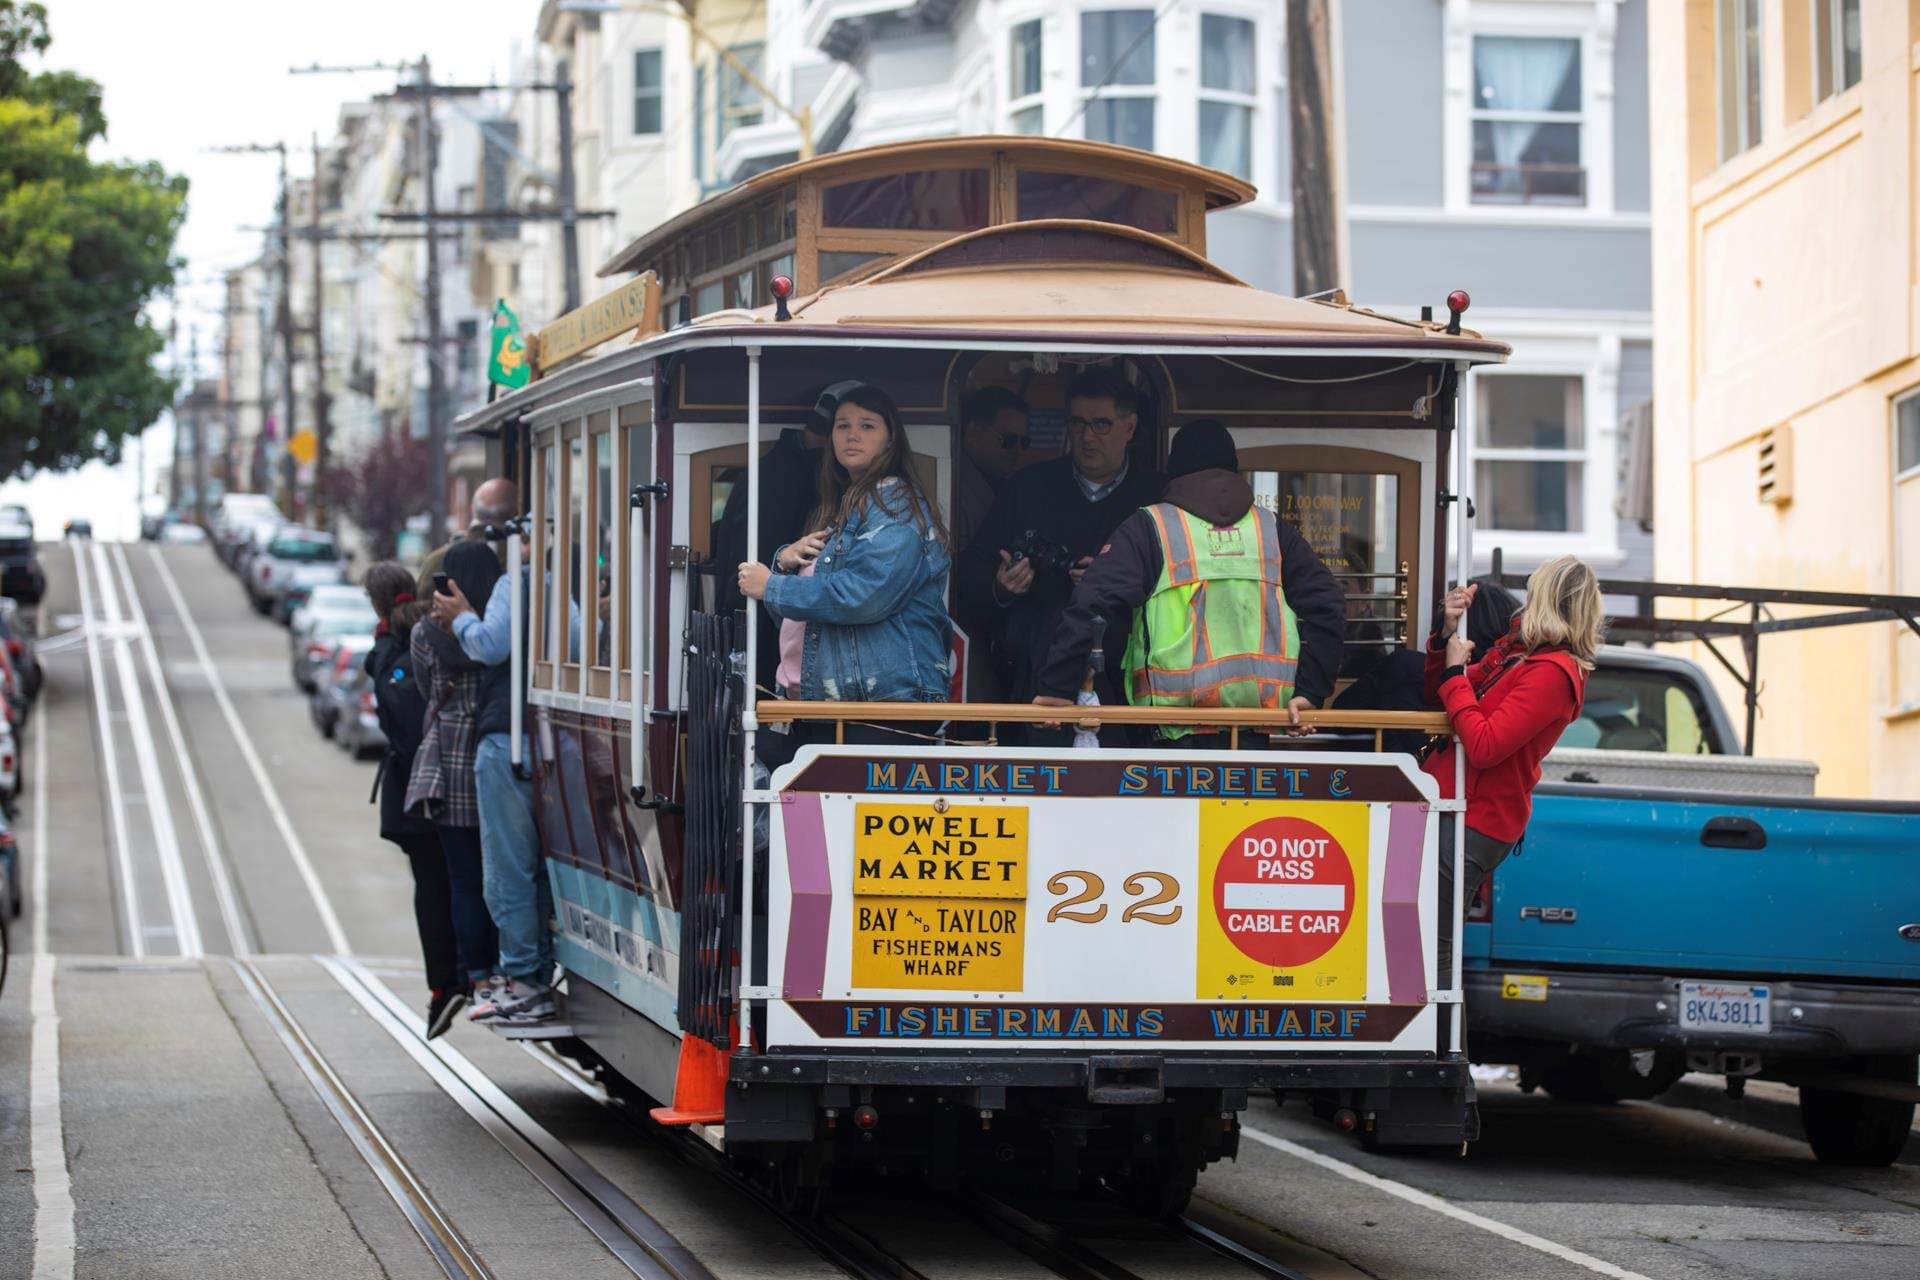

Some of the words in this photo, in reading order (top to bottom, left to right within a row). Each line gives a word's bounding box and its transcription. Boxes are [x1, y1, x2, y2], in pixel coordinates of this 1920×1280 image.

[1340, 495, 1363, 511] WAY
[865, 761, 1068, 793] MARKET
[1119, 764, 1309, 797] STREET
[1329, 769, 1353, 797] &
[864, 815, 1016, 838] POWELL
[903, 840, 977, 856] AND
[1243, 838, 1278, 858] DO
[1281, 839, 1330, 859] NOT
[859, 859, 1018, 881] MARKET
[1257, 860, 1315, 879] PASS
[1047, 870, 1182, 925] 22
[859, 907, 898, 931] BAY
[906, 910, 930, 933] AND
[937, 909, 1017, 934] TAYLOR
[1227, 914, 1293, 933] CABLE
[1299, 914, 1341, 934] CAR
[873, 939, 1002, 957] FISHERMANS
[904, 960, 970, 976] WHARF
[1506, 983, 1518, 997] C
[844, 1006, 1165, 1037] FISHERMANS
[1211, 1008, 1368, 1037] WHARF
[1686, 1000, 1763, 1025] 8K43811
